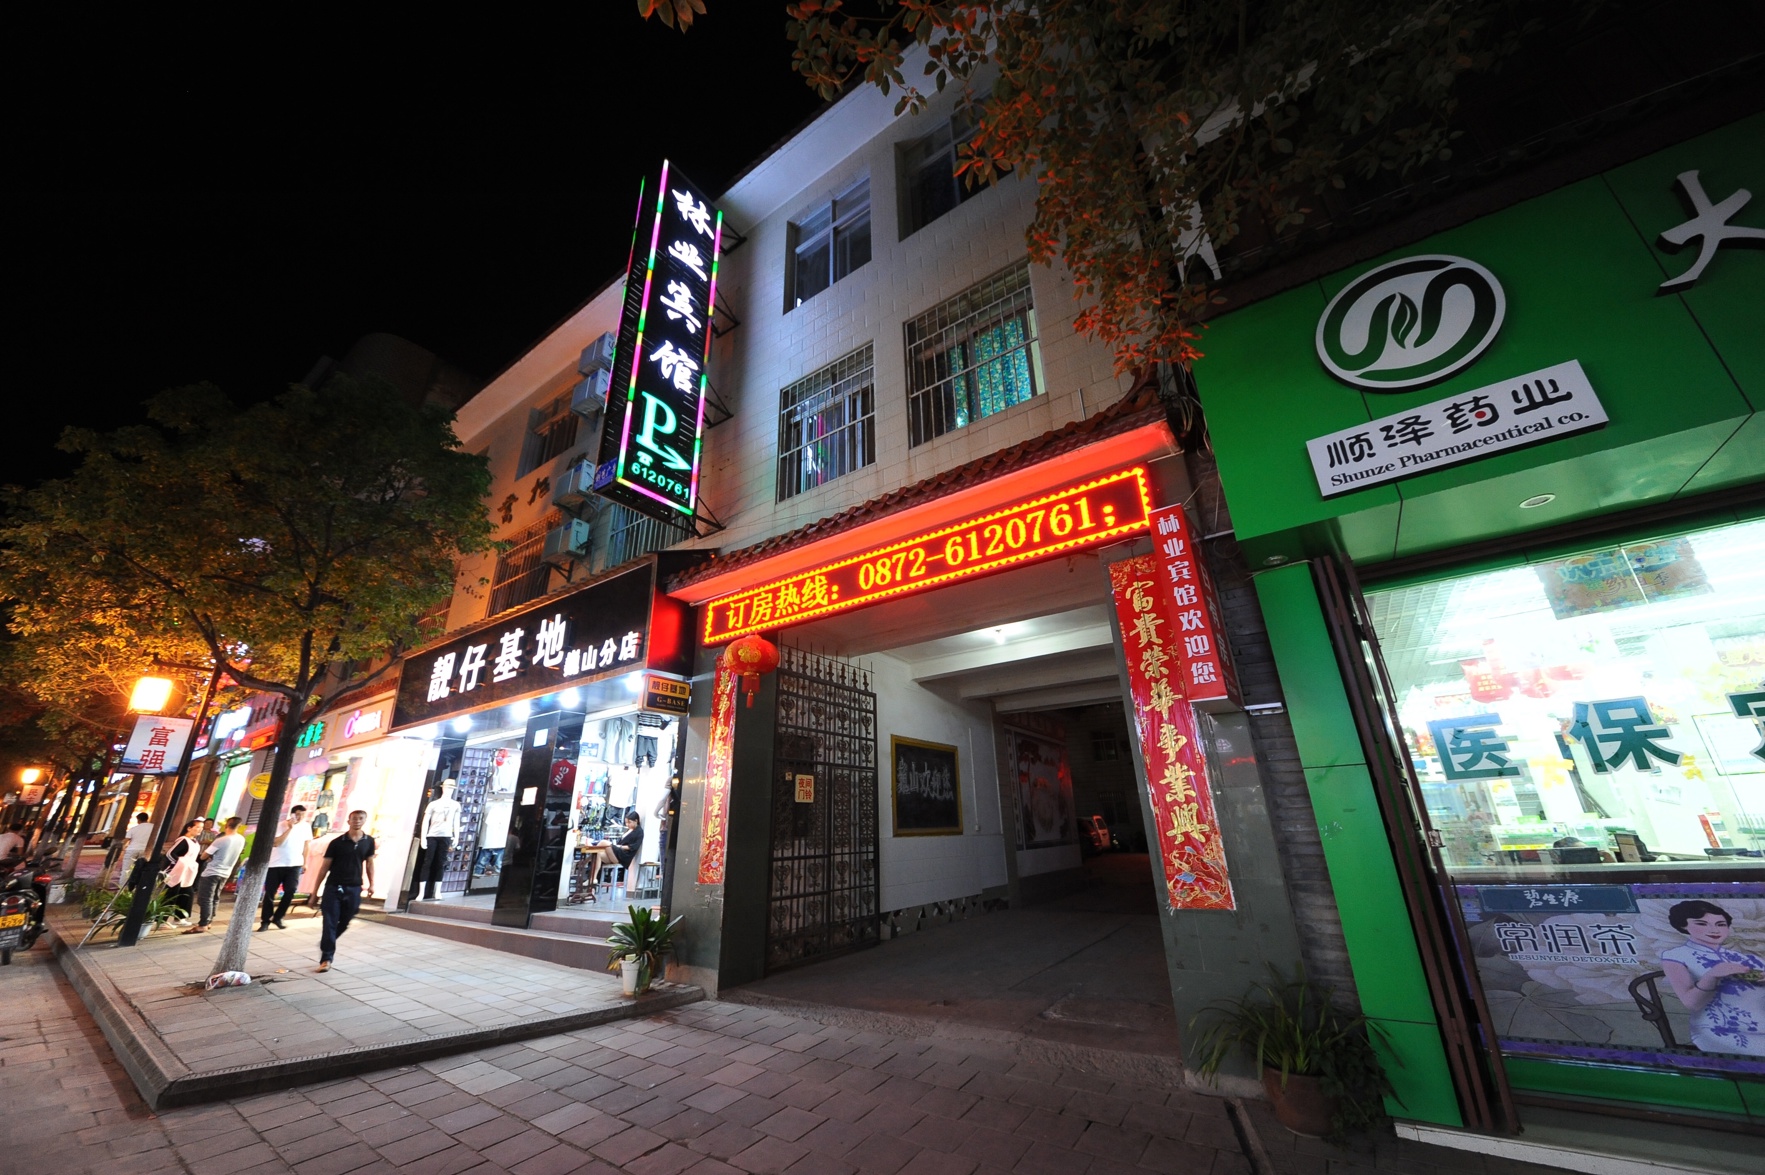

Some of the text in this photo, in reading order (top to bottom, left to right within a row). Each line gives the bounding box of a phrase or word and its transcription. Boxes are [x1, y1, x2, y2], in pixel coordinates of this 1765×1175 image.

[1660, 169, 1765, 287] 大
[650, 189, 715, 394] 林业宾馆
[636, 391, 677, 449] P
[1326, 379, 1573, 468] 顺泽药业
[1330, 411, 1590, 487] Shunze Pharmaceutical co.
[631, 462, 690, 499] 6120761
[1157, 513, 1217, 685] 林业宾馆欢迎您
[138, 726, 176, 770] 富强
[1523, 889, 1583, 909] 碧生源
[1494, 922, 1637, 956] 常润茶
[1571, 955, 1611, 963] DETOX
